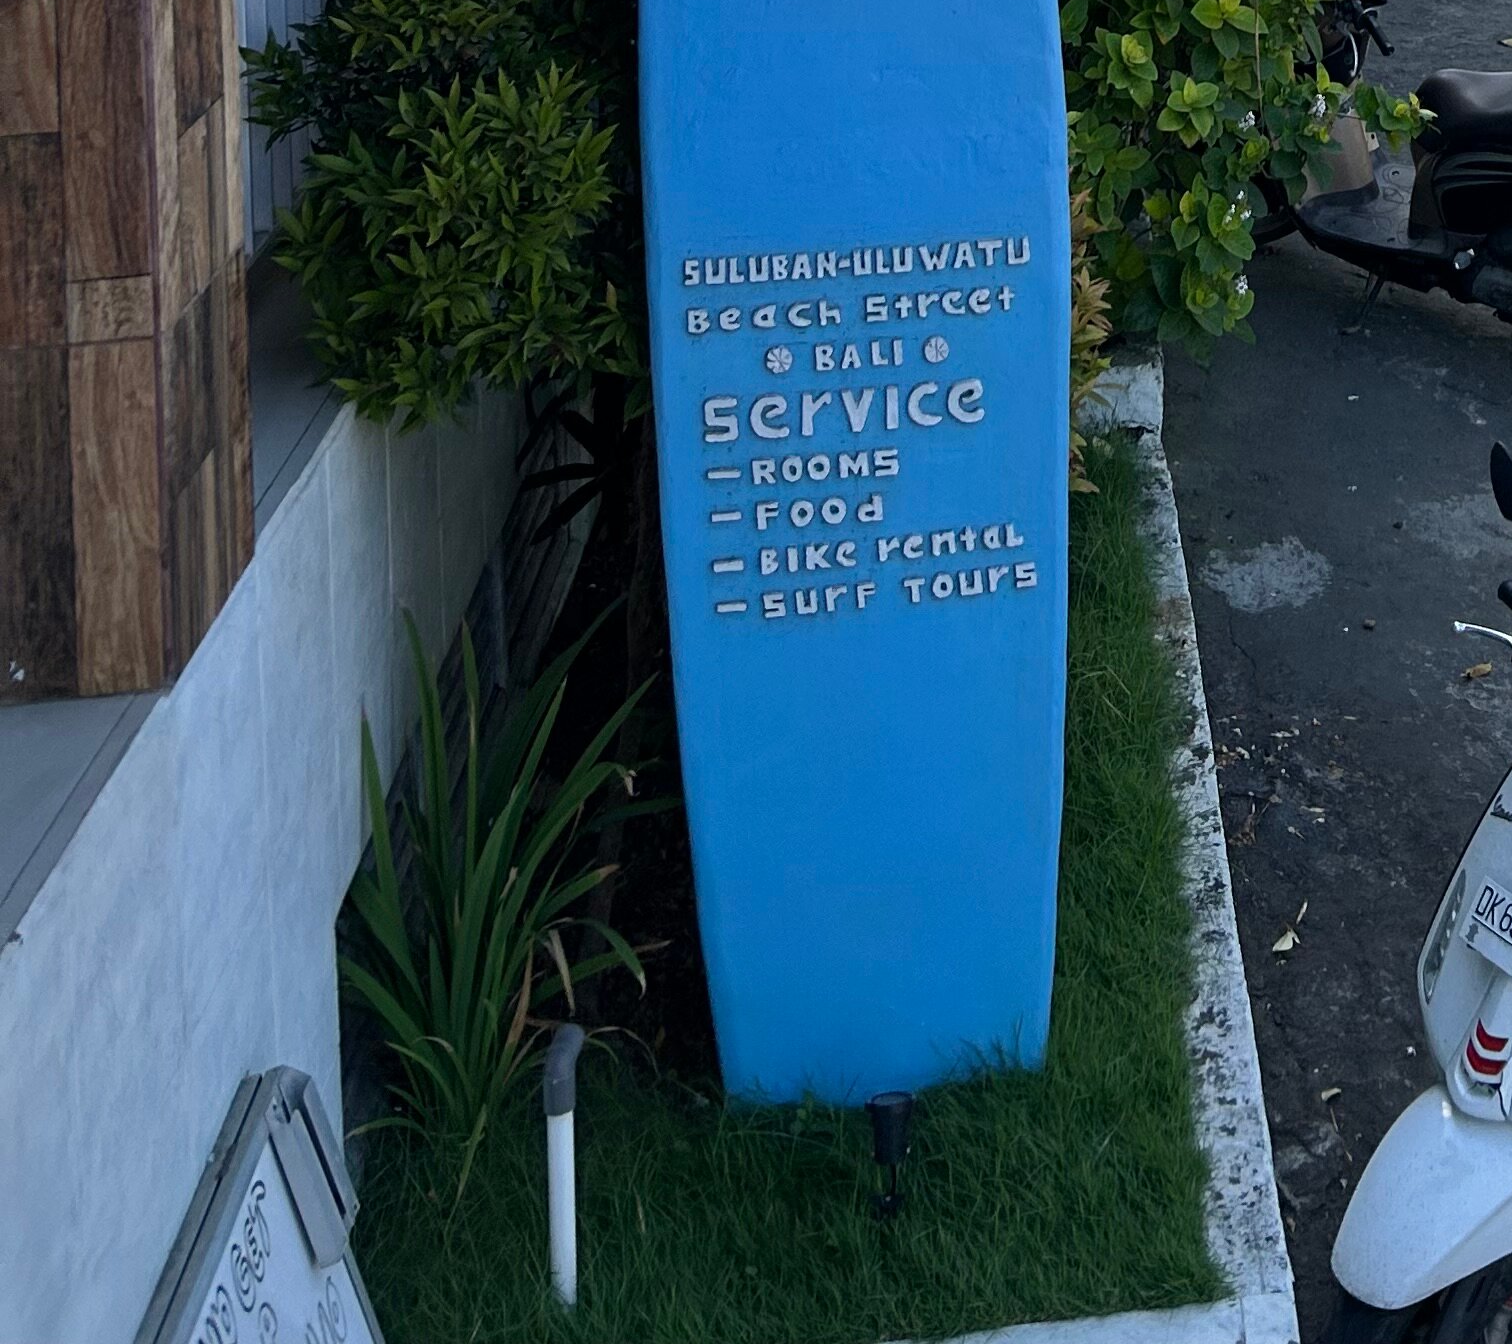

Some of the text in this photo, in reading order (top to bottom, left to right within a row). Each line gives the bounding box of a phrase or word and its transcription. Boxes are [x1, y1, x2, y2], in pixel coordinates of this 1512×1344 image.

[682, 235, 1031, 287] SULUBAN-ULUWATU
[814, 337, 904, 372] BALI
[751, 447, 900, 486] ROOMS
